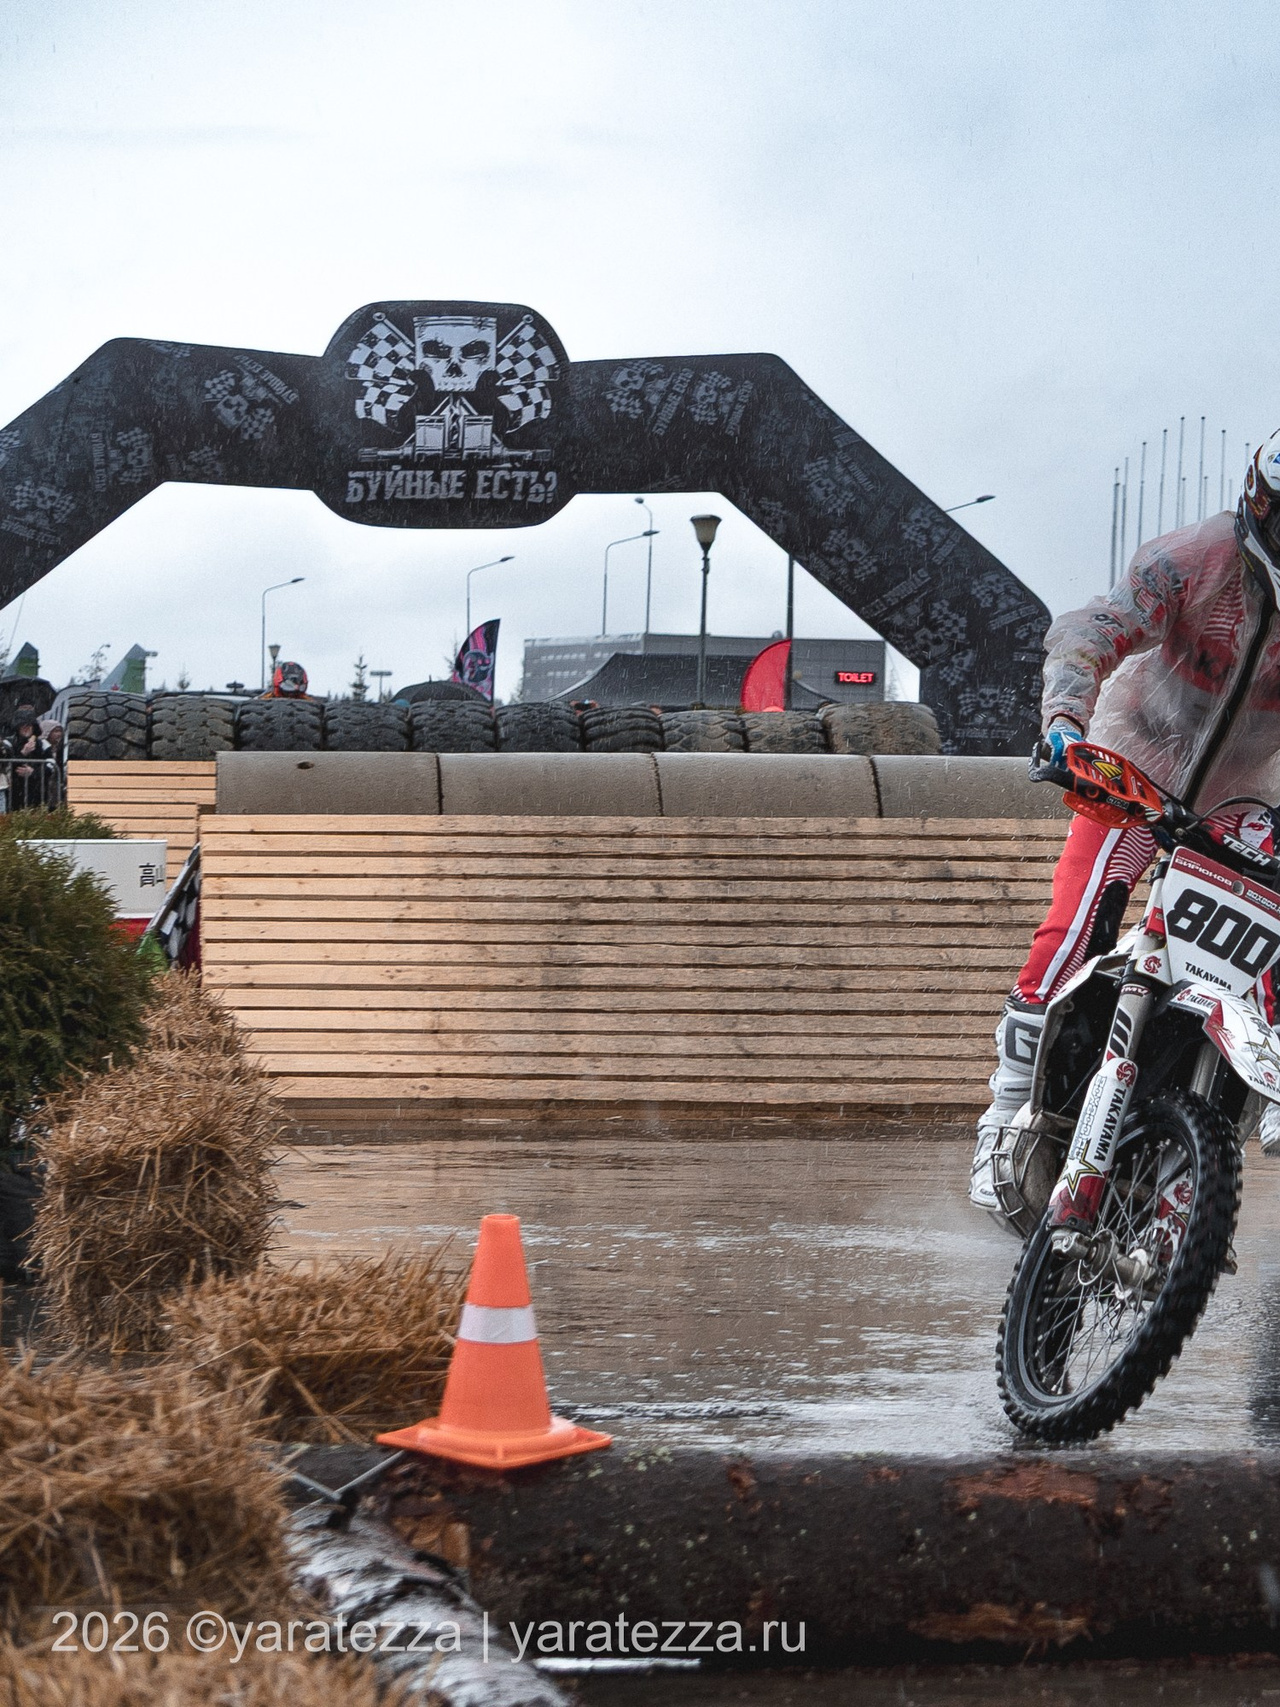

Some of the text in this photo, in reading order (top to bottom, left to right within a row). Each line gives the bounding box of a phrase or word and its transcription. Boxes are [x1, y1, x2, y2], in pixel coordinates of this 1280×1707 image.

[346, 463, 558, 503] БУЙНЫЕ ЕСТЬ?
[838, 672, 874, 683] TOILET
[1222, 835, 1271, 866] TECH
[1174, 858, 1233, 887] БИРЮКОВ
[1185, 962, 1232, 991] TAKAYAMA
[1094, 1088, 1126, 1162] TAKAYAMA
